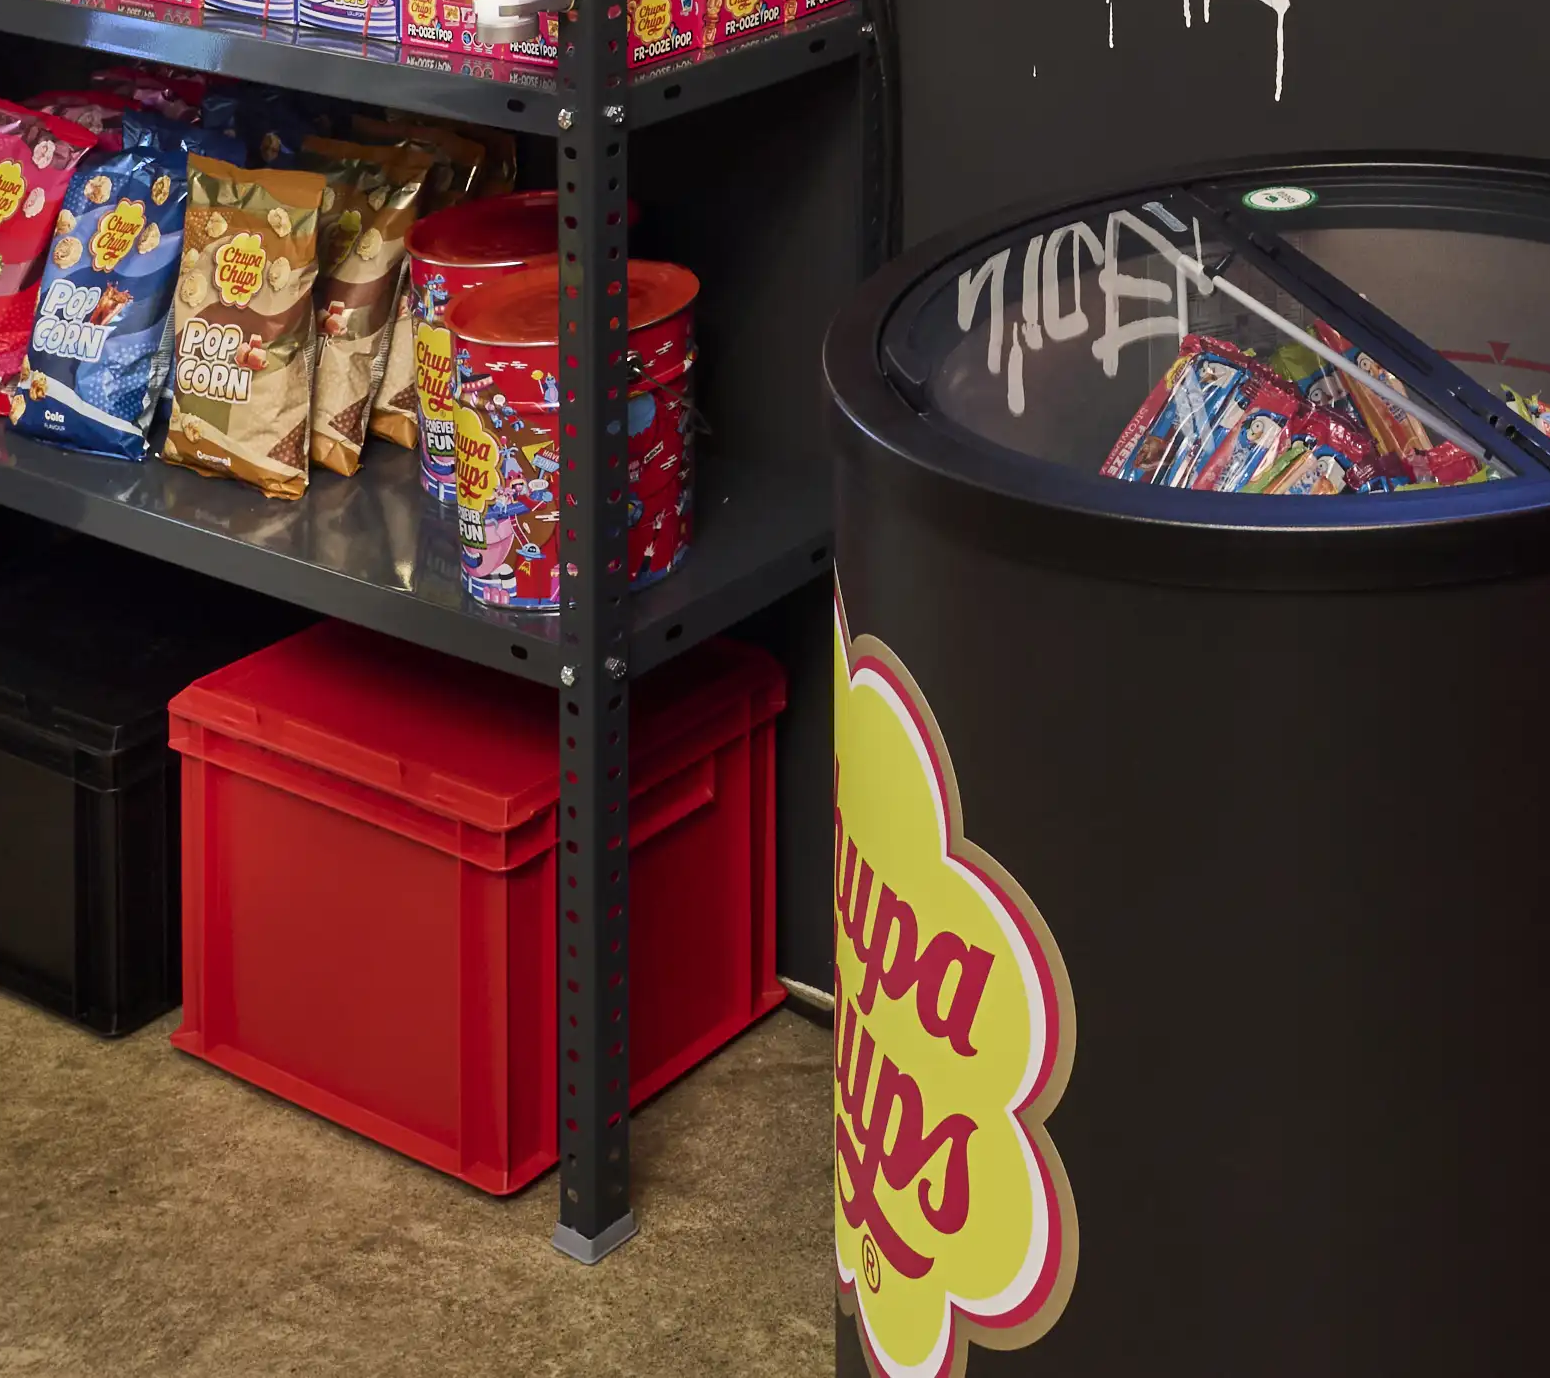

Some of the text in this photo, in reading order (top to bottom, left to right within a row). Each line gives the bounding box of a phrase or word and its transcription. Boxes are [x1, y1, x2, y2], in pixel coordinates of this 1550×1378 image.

[223, 244, 262, 268] Chupa
[219, 264, 259, 295] Chups
[42, 279, 102, 322] POP
[32, 316, 106, 362] CORN
[181, 318, 243, 361] POP
[177, 356, 252, 402] CORN
[44, 409, 65, 423] Cola
[459, 520, 484, 543] FUN
